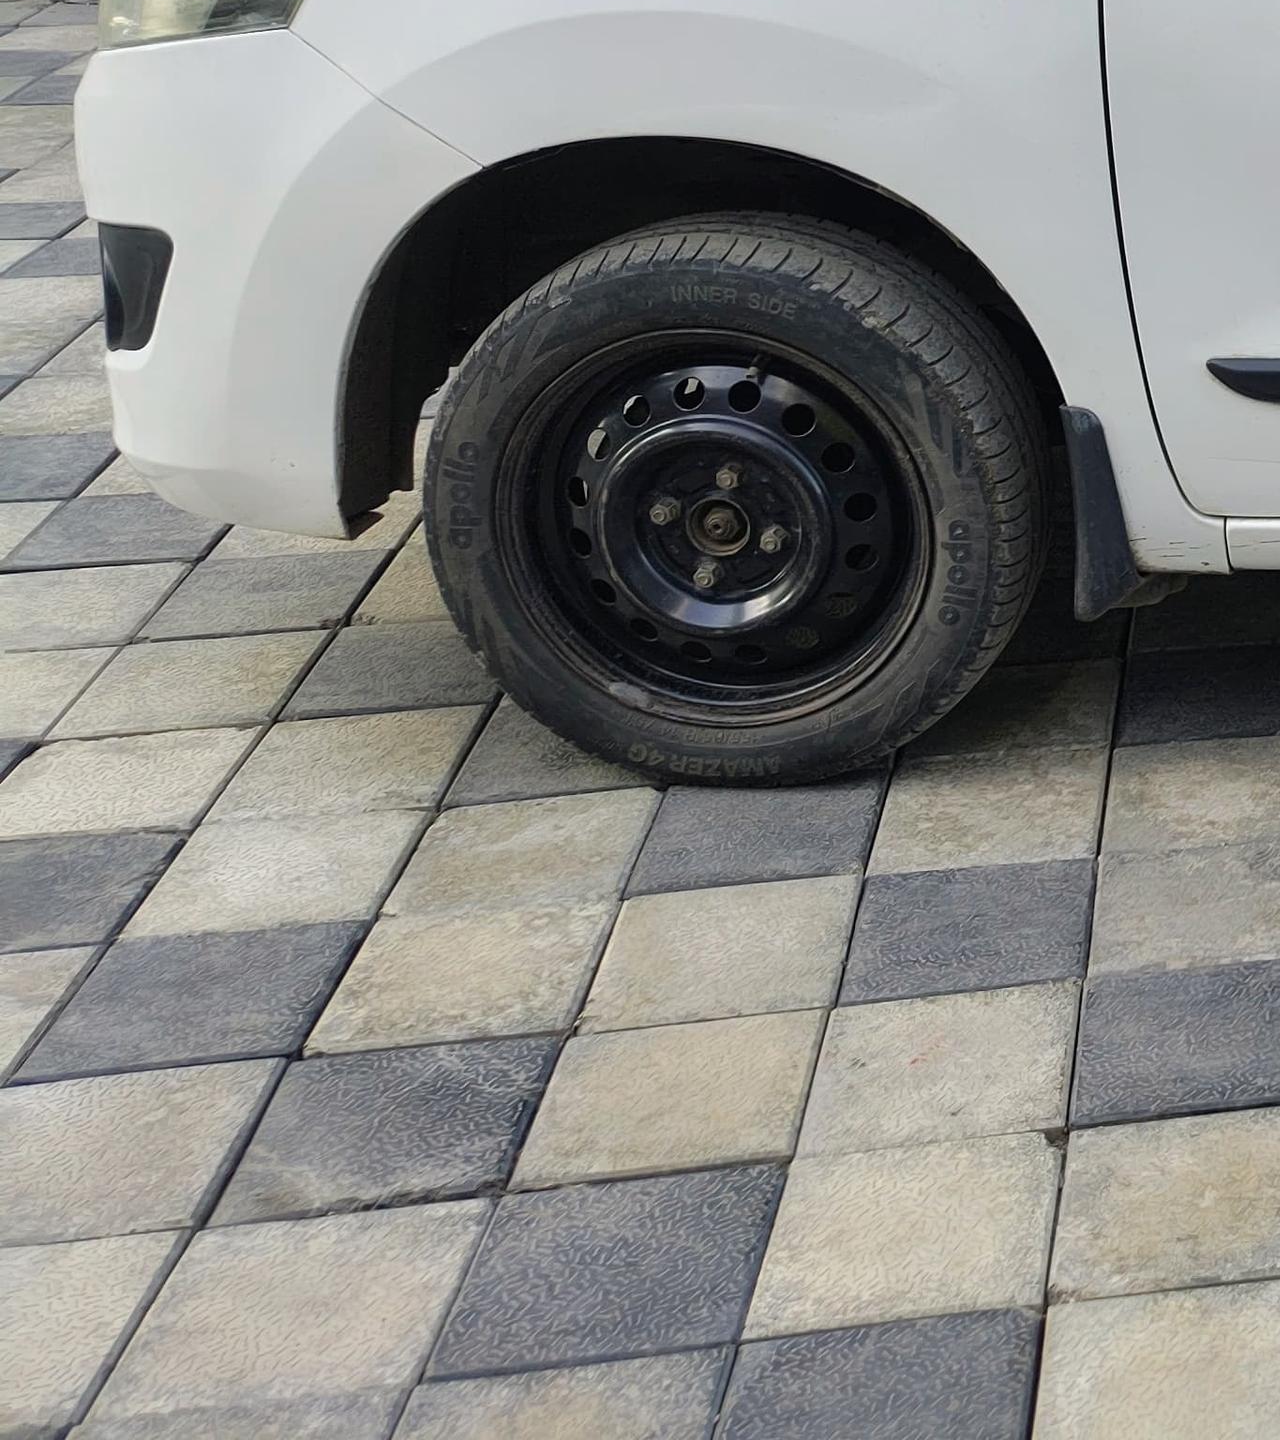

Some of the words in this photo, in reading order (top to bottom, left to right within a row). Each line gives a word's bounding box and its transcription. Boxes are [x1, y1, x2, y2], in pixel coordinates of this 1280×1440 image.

[671, 284, 738, 305] INNER
[748, 292, 798, 320] SIDE
[442, 441, 482, 550] apollo
[938, 519, 978, 626] apollo
